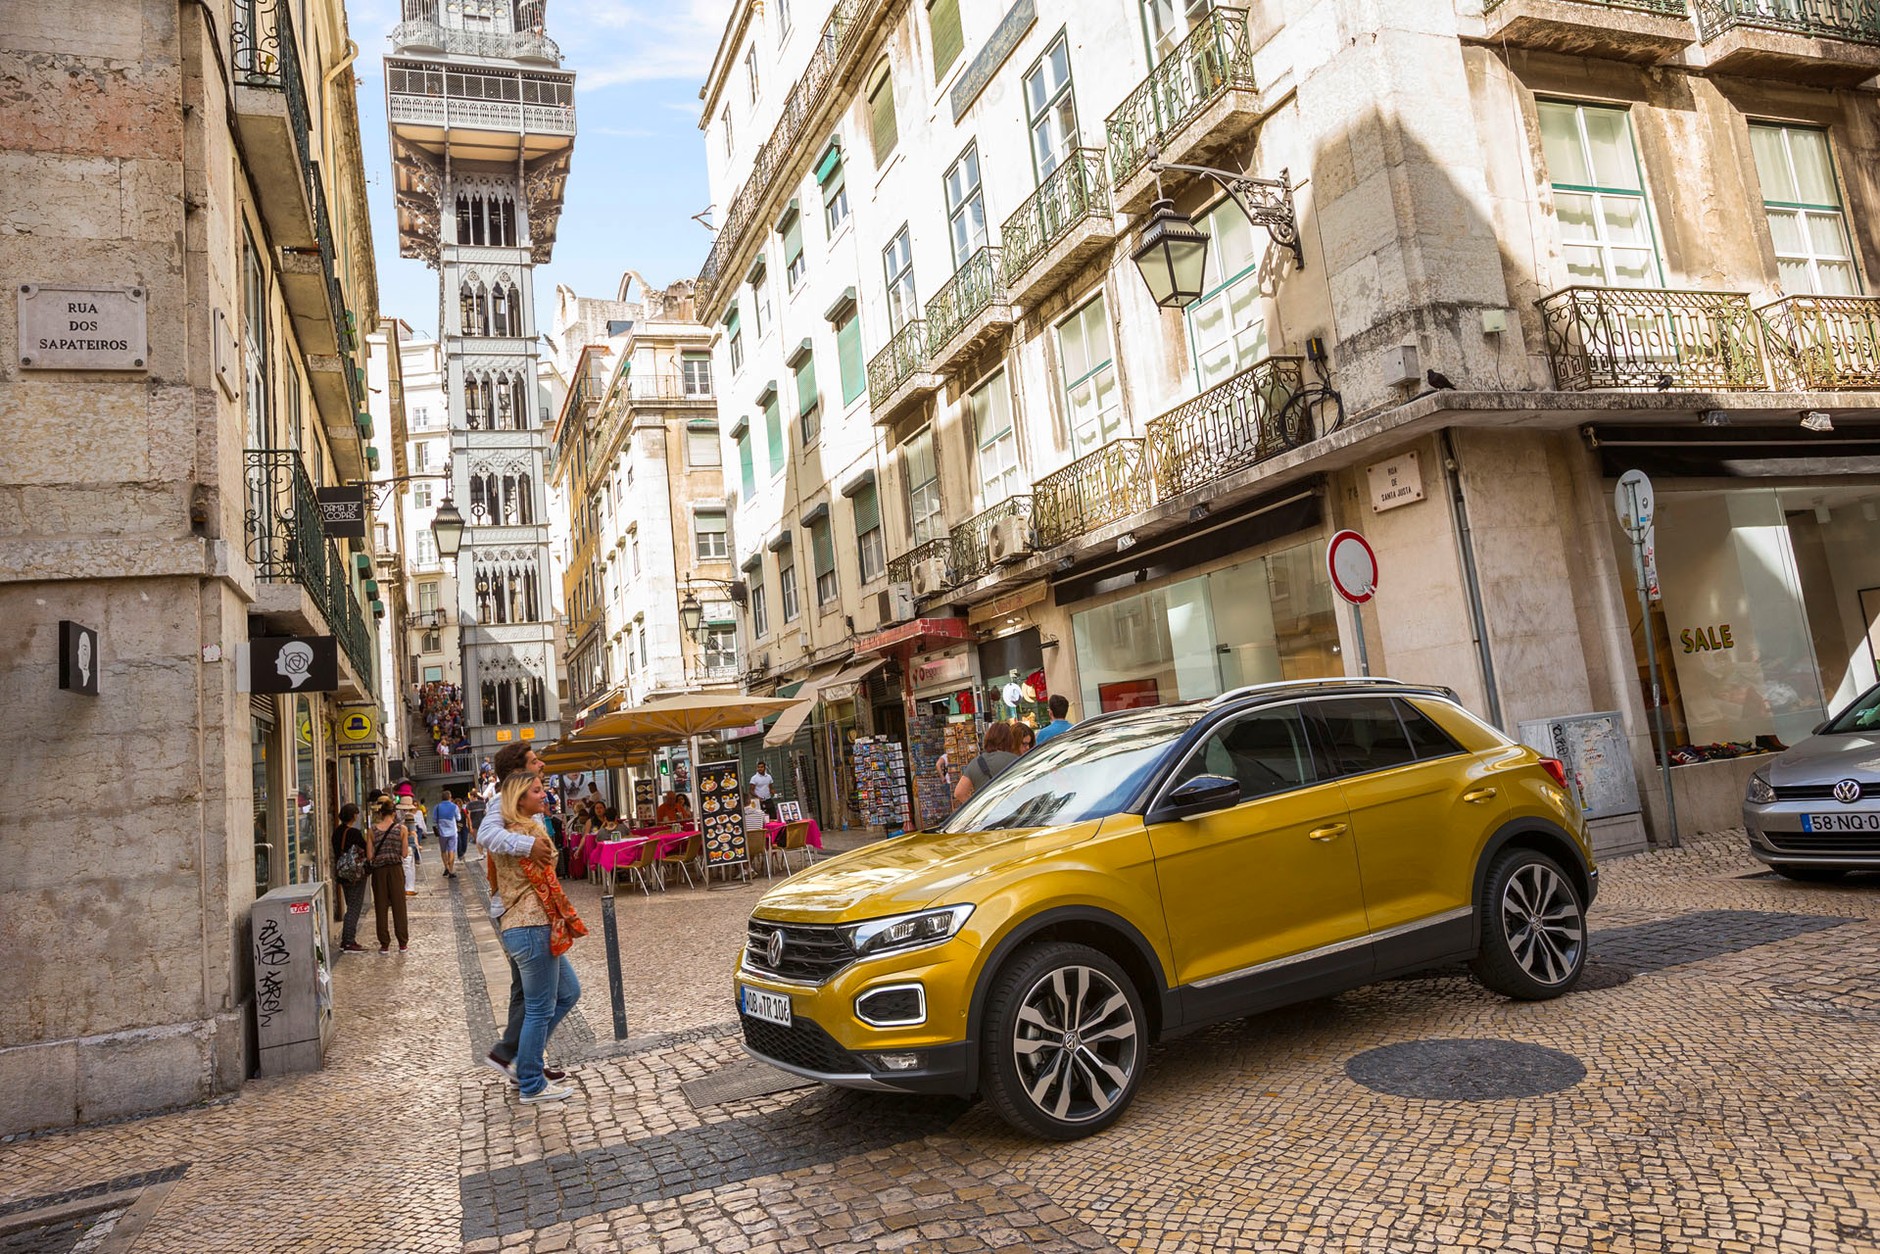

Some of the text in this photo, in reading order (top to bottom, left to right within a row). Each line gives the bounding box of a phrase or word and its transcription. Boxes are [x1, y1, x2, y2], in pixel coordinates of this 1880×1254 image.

[68, 303, 98, 313] RUA
[69, 321, 98, 331] DOS
[39, 339, 128, 350] SAPATEIROS
[1391, 478, 1397, 486] DE
[1381, 486, 1412, 501] SANTA JUSTA
[324, 504, 345, 512] DAMA
[326, 511, 356, 519] COPAS
[1680, 624, 1734, 653] SALE
[761, 995, 773, 1019] TR
[773, 998, 790, 1022] 106
